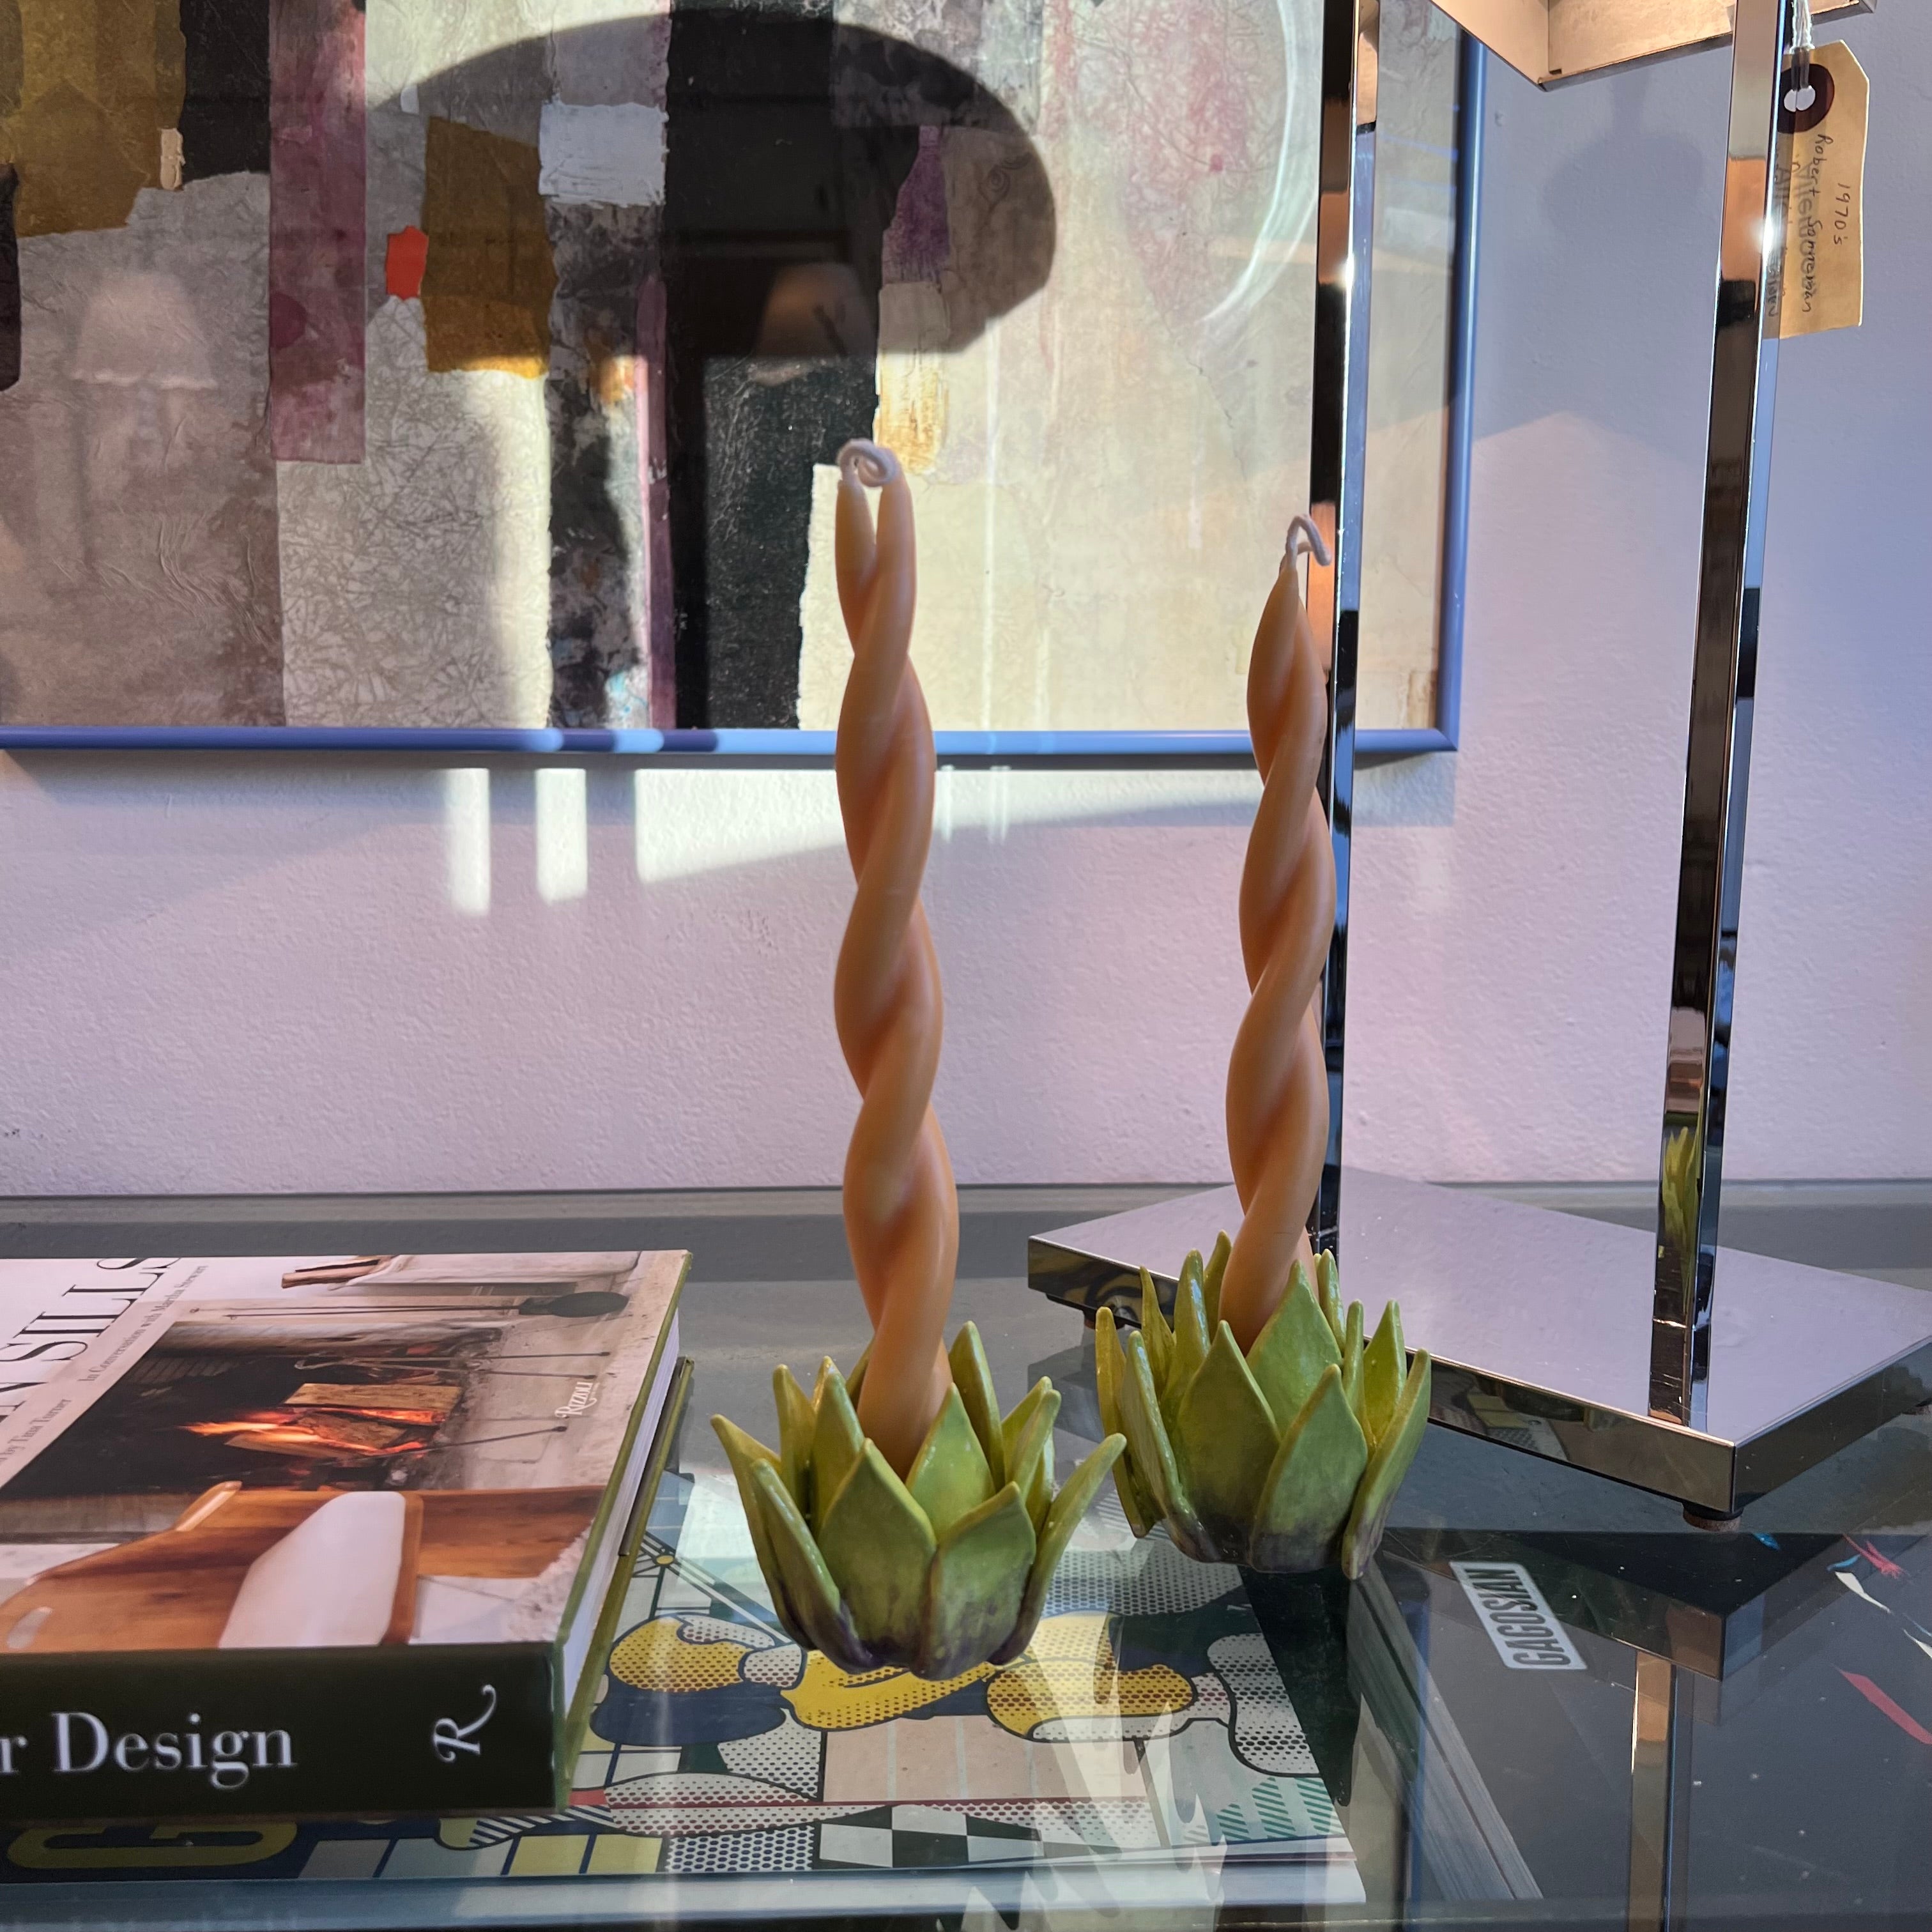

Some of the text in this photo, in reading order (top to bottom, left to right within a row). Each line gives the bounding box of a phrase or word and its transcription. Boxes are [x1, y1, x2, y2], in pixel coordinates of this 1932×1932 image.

[1809, 134, 1834, 197] Robert
[1834, 183, 1850, 245] 1970's
[77, 1264, 208, 1381] In Conversation with Martha Stewart
[7, 1425, 44, 1444] Tina
[28, 1399, 72, 1425] Turner
[554, 1381, 598, 1418] RIZZOLI
[1464, 1568, 1572, 1666] GAGOSIAN
[51, 1712, 298, 1789] Design
